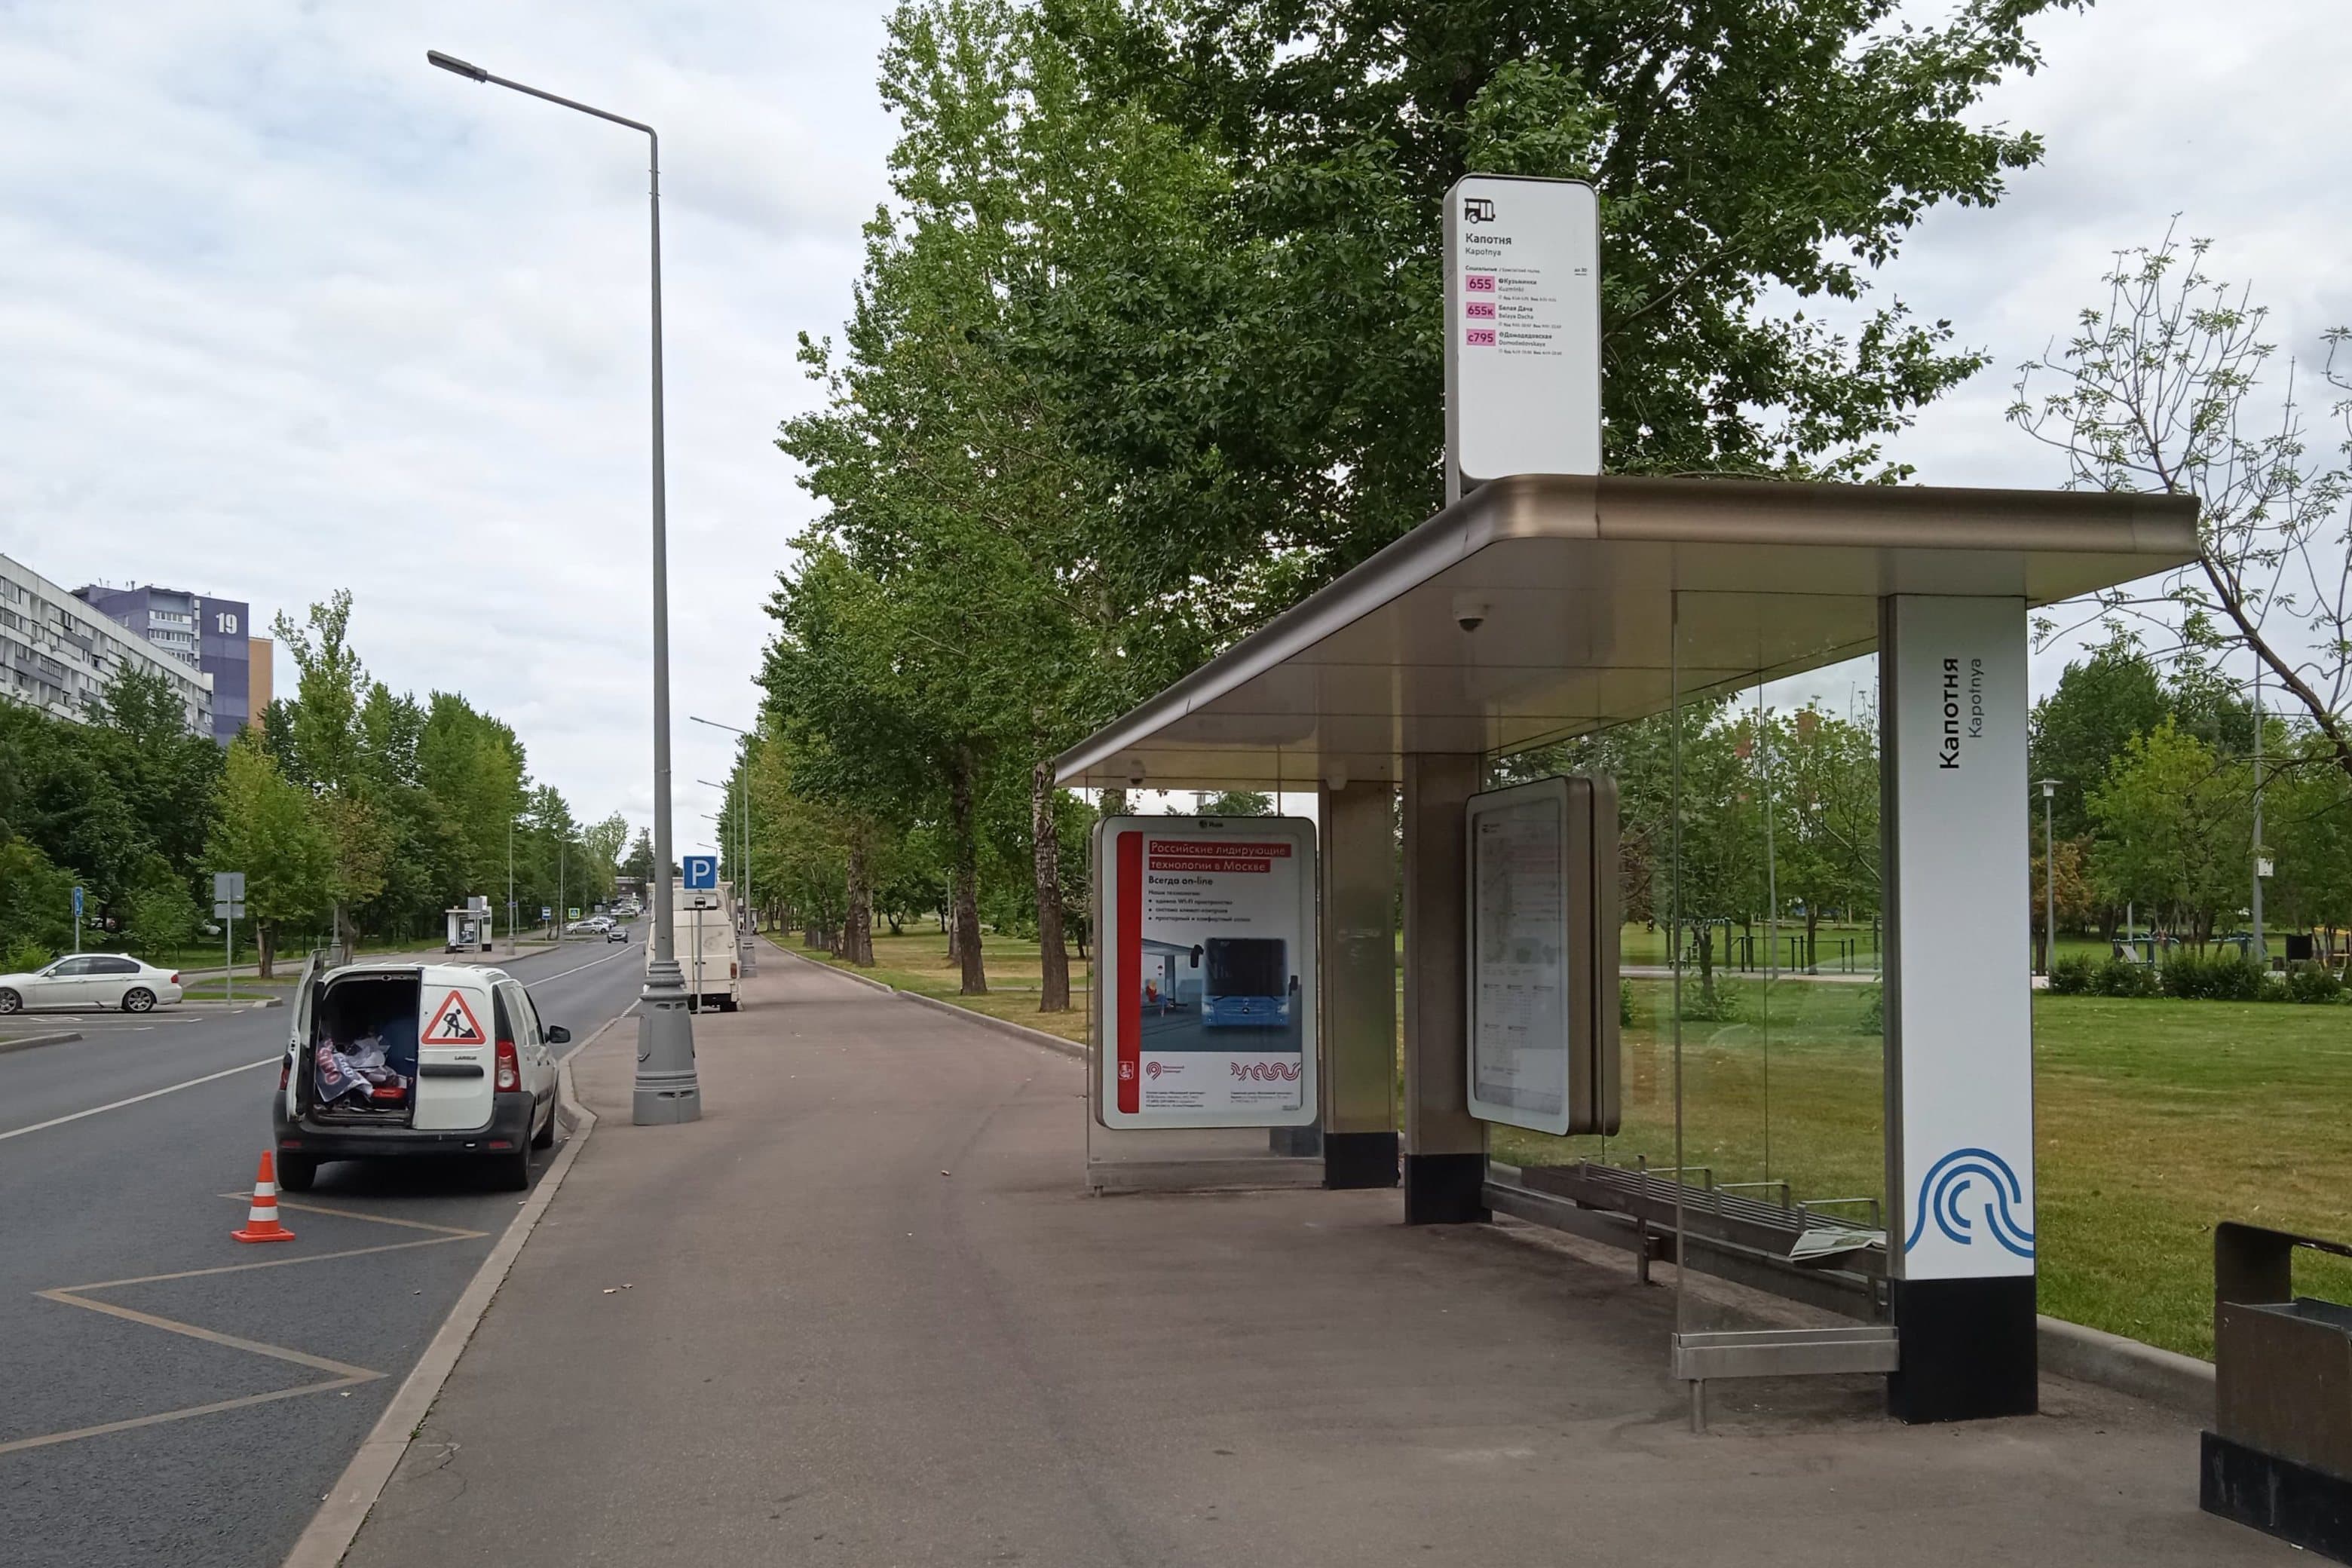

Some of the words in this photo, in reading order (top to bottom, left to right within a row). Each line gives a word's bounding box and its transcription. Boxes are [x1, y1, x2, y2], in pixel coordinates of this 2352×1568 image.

[1465, 233, 1512, 245] Капотня
[1465, 247, 1502, 257] Kapotnya
[1469, 278, 1492, 289] 655
[1504, 277, 1537, 286] Кузьминки
[216, 612, 237, 635] 19
[1968, 658, 1984, 738] Kapotnya
[1940, 658, 1959, 769] Капотня
[1150, 841, 1213, 854] Российские
[1216, 845, 1285, 858] лидирующие
[1151, 860, 1212, 870] технологии
[1214, 862, 1220, 871] в
[1223, 860, 1266, 871] Москве
[692, 860, 710, 887] P
[1148, 876, 1180, 886] Всегда
[1181, 875, 1213, 886] on-line
